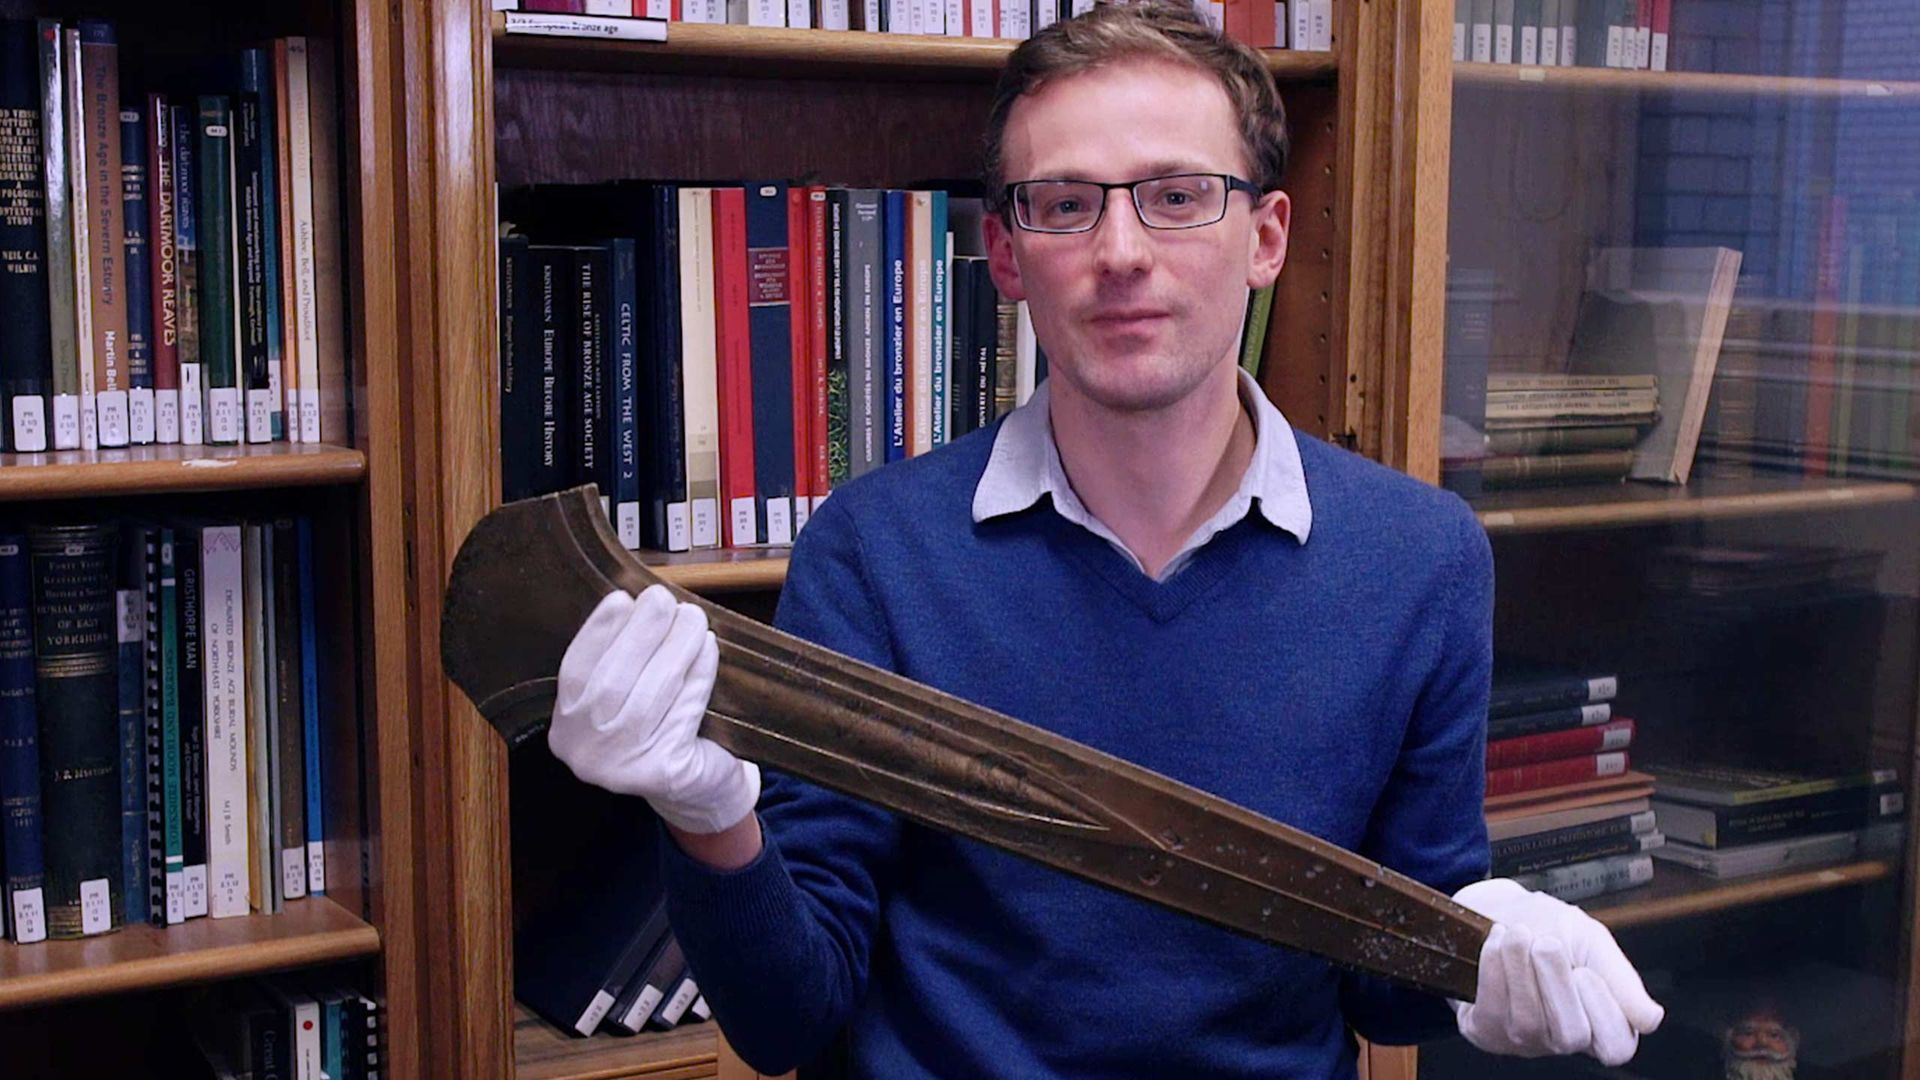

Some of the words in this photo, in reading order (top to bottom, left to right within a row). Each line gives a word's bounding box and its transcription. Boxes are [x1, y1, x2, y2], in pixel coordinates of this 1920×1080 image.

[604, 24, 619, 35] age
[96, 66, 106, 89] The
[96, 93, 107, 139] Bronze
[179, 123, 191, 143] the
[96, 142, 109, 167] Age
[99, 170, 109, 182] in
[161, 160, 171, 187] THE
[12, 198, 28, 207] AND
[100, 185, 110, 206] the
[6, 216, 33, 225] STUDY
[101, 209, 112, 253] Severn
[160, 192, 174, 285] DARTMOOR
[2, 251, 22, 260] NEIL
[300, 258, 310, 276] Bell,
[101, 257, 114, 305] Estuary
[302, 279, 310, 295] and
[581, 263, 592, 288] THE
[892, 260, 904, 304] Europe
[918, 259, 929, 303] Europe
[933, 259, 945, 303] Europe
[543, 265, 552, 322] KRISTIANSEN
[582, 291, 592, 318] RISE
[864, 294, 871, 305] EN
[162, 289, 176, 346] REAVES
[303, 297, 312, 341] Proudfoot
[621, 303, 631, 347] CELTIC
[864, 307, 872, 335] ANCIEN
[894, 307, 902, 322] en
[919, 306, 927, 321] en
[934, 305, 943, 321] en
[582, 321, 592, 337] OF
[105, 331, 116, 366] Martin
[543, 329, 555, 373] EUROPE
[864, 338, 872, 368] BRONZE
[893, 324, 903, 375] bronzier
[918, 325, 927, 374] bronzier
[933, 323, 943, 373] bronzier
[978, 347, 987, 373] MÉTAL
[583, 340, 593, 389] BRONZE
[621, 352, 632, 391] FROM
[865, 370, 872, 381] DU
[106, 369, 117, 392] Bell
[893, 378, 903, 394] du
[918, 377, 927, 393] du
[933, 376, 943, 392] du
[979, 375, 986, 389] DU
[543, 376, 555, 418] BEFORE
[583, 391, 593, 416] AGE
[622, 396, 632, 424] THE
[863, 383, 872, 415] SOCIÉTÉS
[978, 392, 987, 428] OUVERTE
[865, 417, 873, 426] ET
[893, 397, 903, 446] L'Atelier
[918, 397, 927, 444] L'Atelier
[933, 394, 943, 443] L'Atelier
[544, 421, 556, 467] HISTORY
[584, 418, 594, 469] SOCIETY
[622, 429, 633, 465] WEST
[865, 427, 873, 462] CULTURES
[623, 471, 632, 479] 2
[184, 568, 197, 637] GRISTHORPE
[225, 589, 233, 636] EXCAVATED
[57, 620, 71, 629] OF
[211, 623, 219, 634] OF
[47, 632, 109, 646] YORKSHIRE
[186, 641, 197, 669] MAN
[226, 639, 234, 674] BRONZE
[213, 695, 222, 739] YORKSHIRE
[228, 699, 236, 728] BURIAL
[229, 733, 237, 772] MOUNDS
[168, 782, 180, 846] YORKSHIRE
[224, 824, 232, 845] Smith
[1495, 845, 1520, 858] LAND
